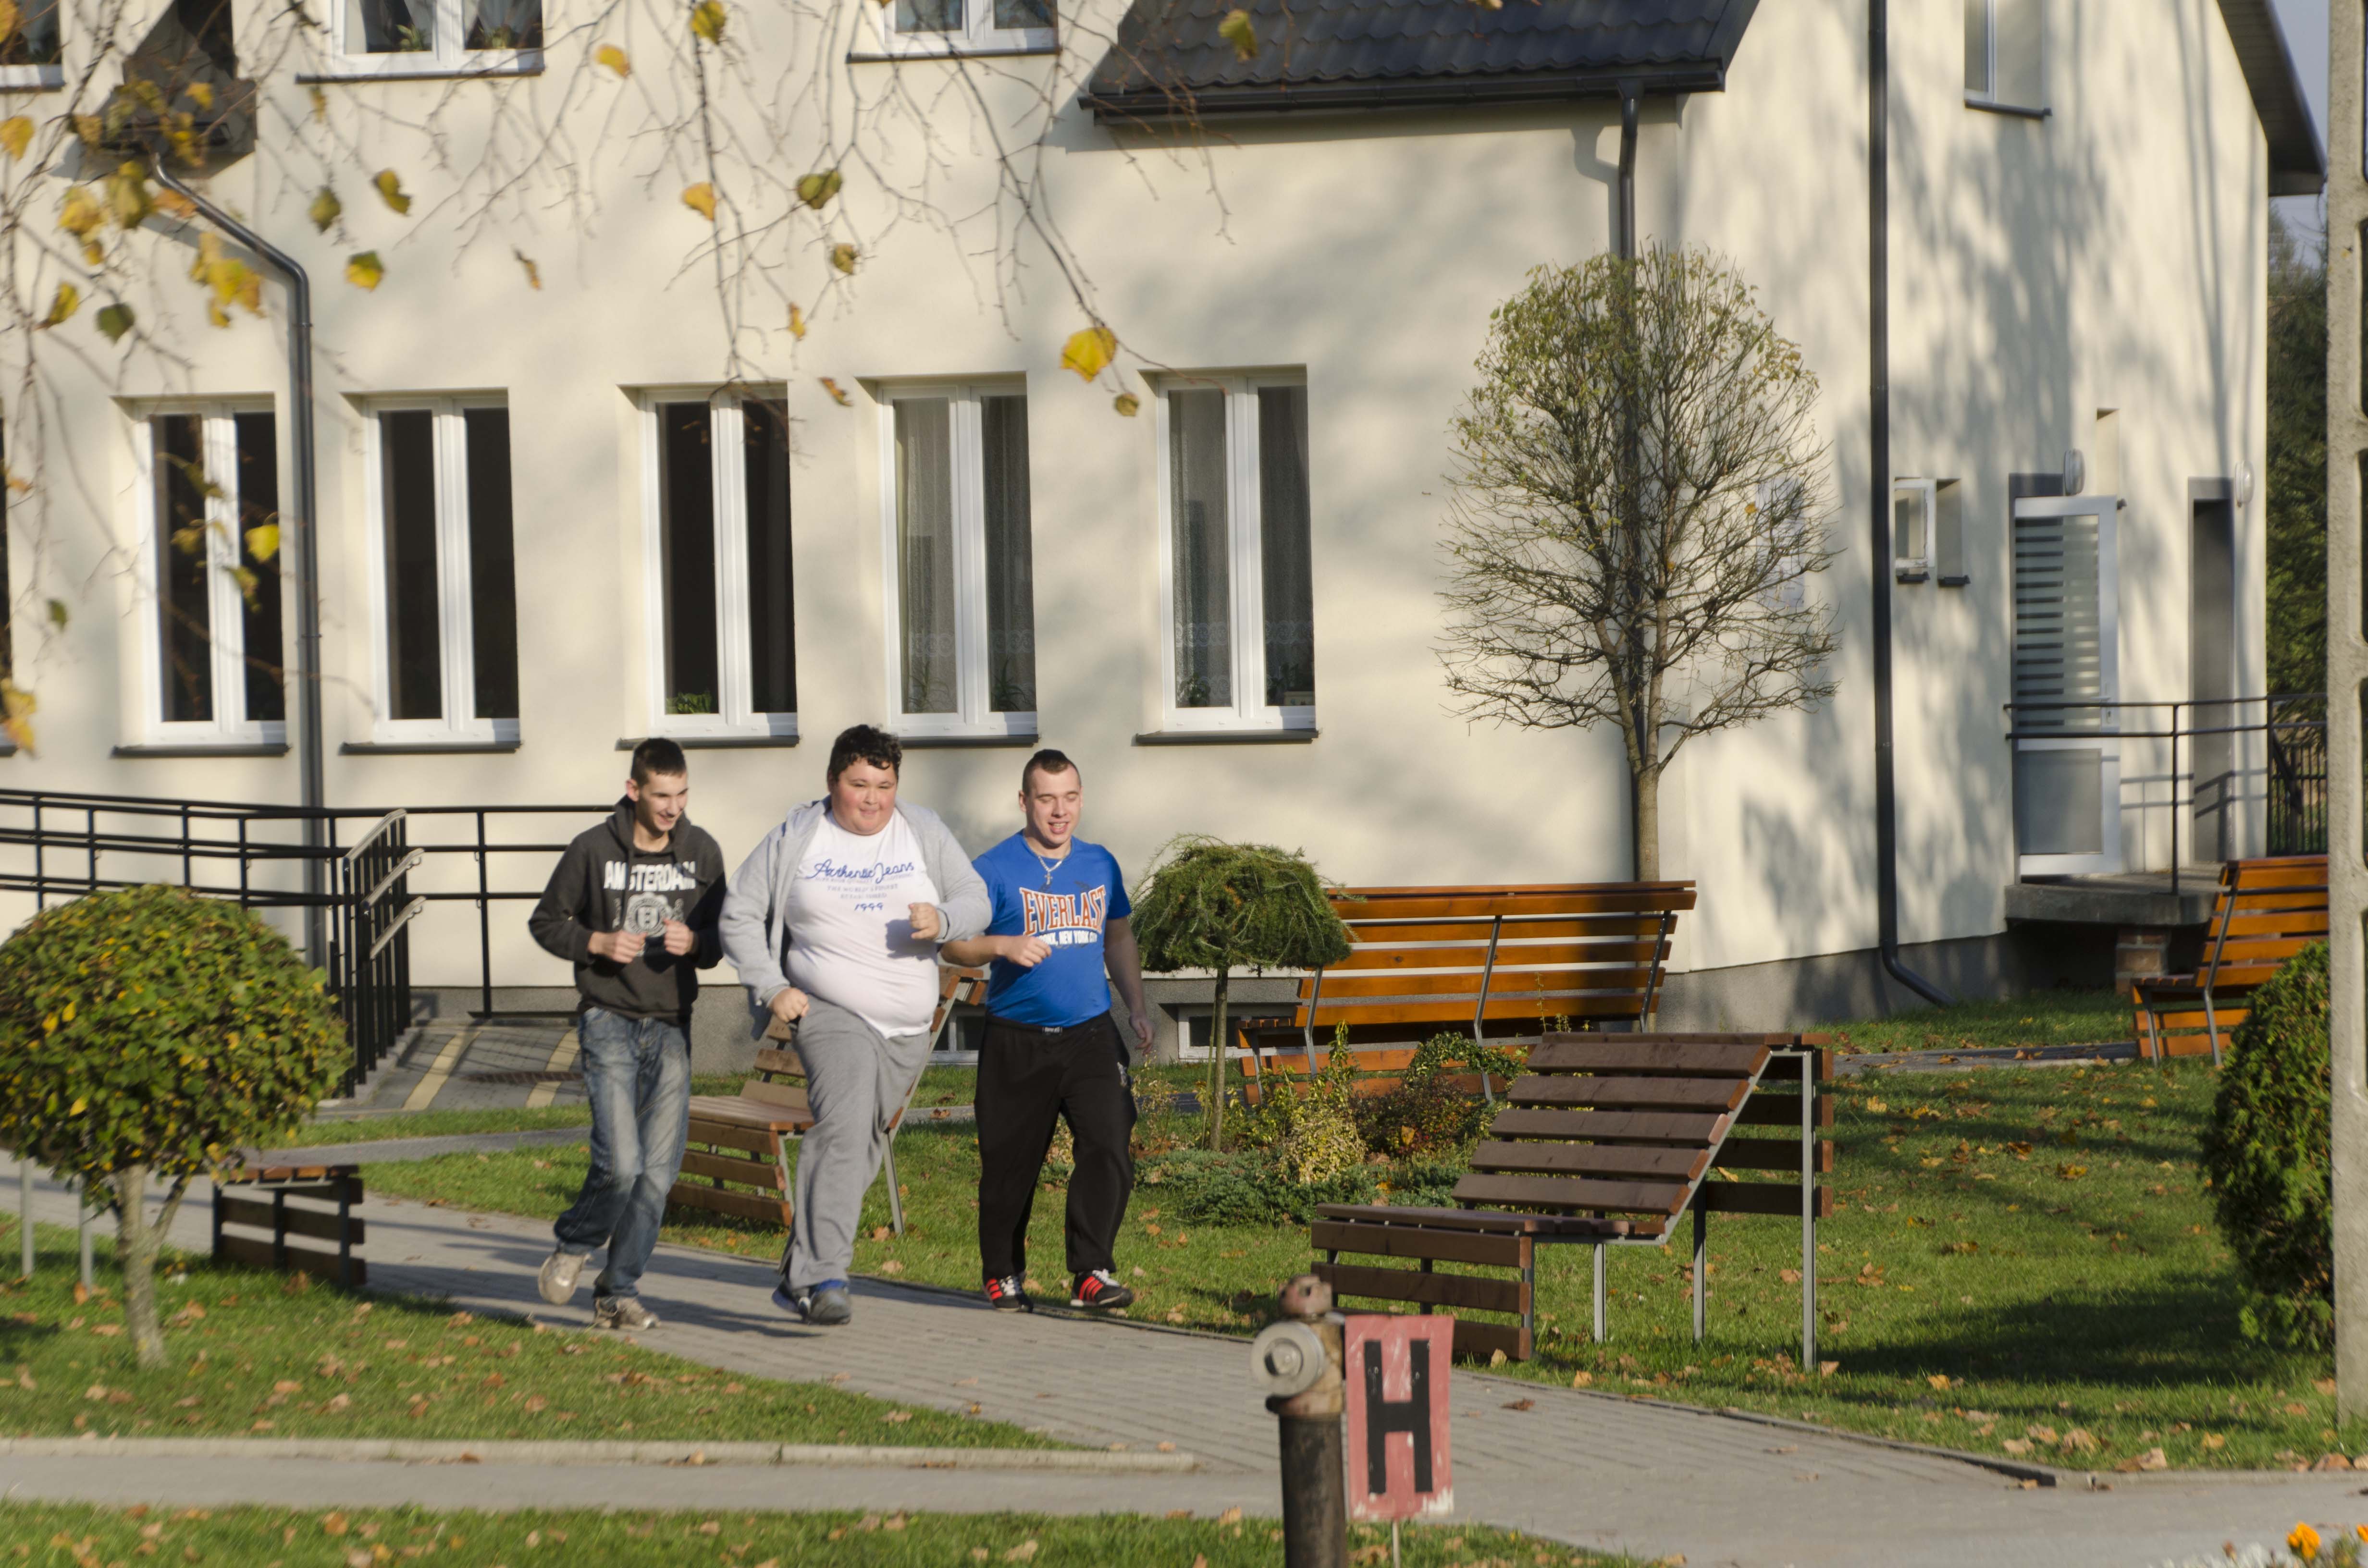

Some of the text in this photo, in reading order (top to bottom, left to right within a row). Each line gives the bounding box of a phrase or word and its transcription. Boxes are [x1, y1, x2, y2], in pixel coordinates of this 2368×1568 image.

[604, 860, 696, 891] AMSTERDAM
[805, 858, 914, 884] Authentic Jeans
[854, 902, 884, 911] 1999
[1019, 885, 1106, 936] EVERLAST
[1059, 931, 1073, 944] NEW
[1073, 930, 1089, 944] YORK
[1364, 1339, 1433, 1494] H
